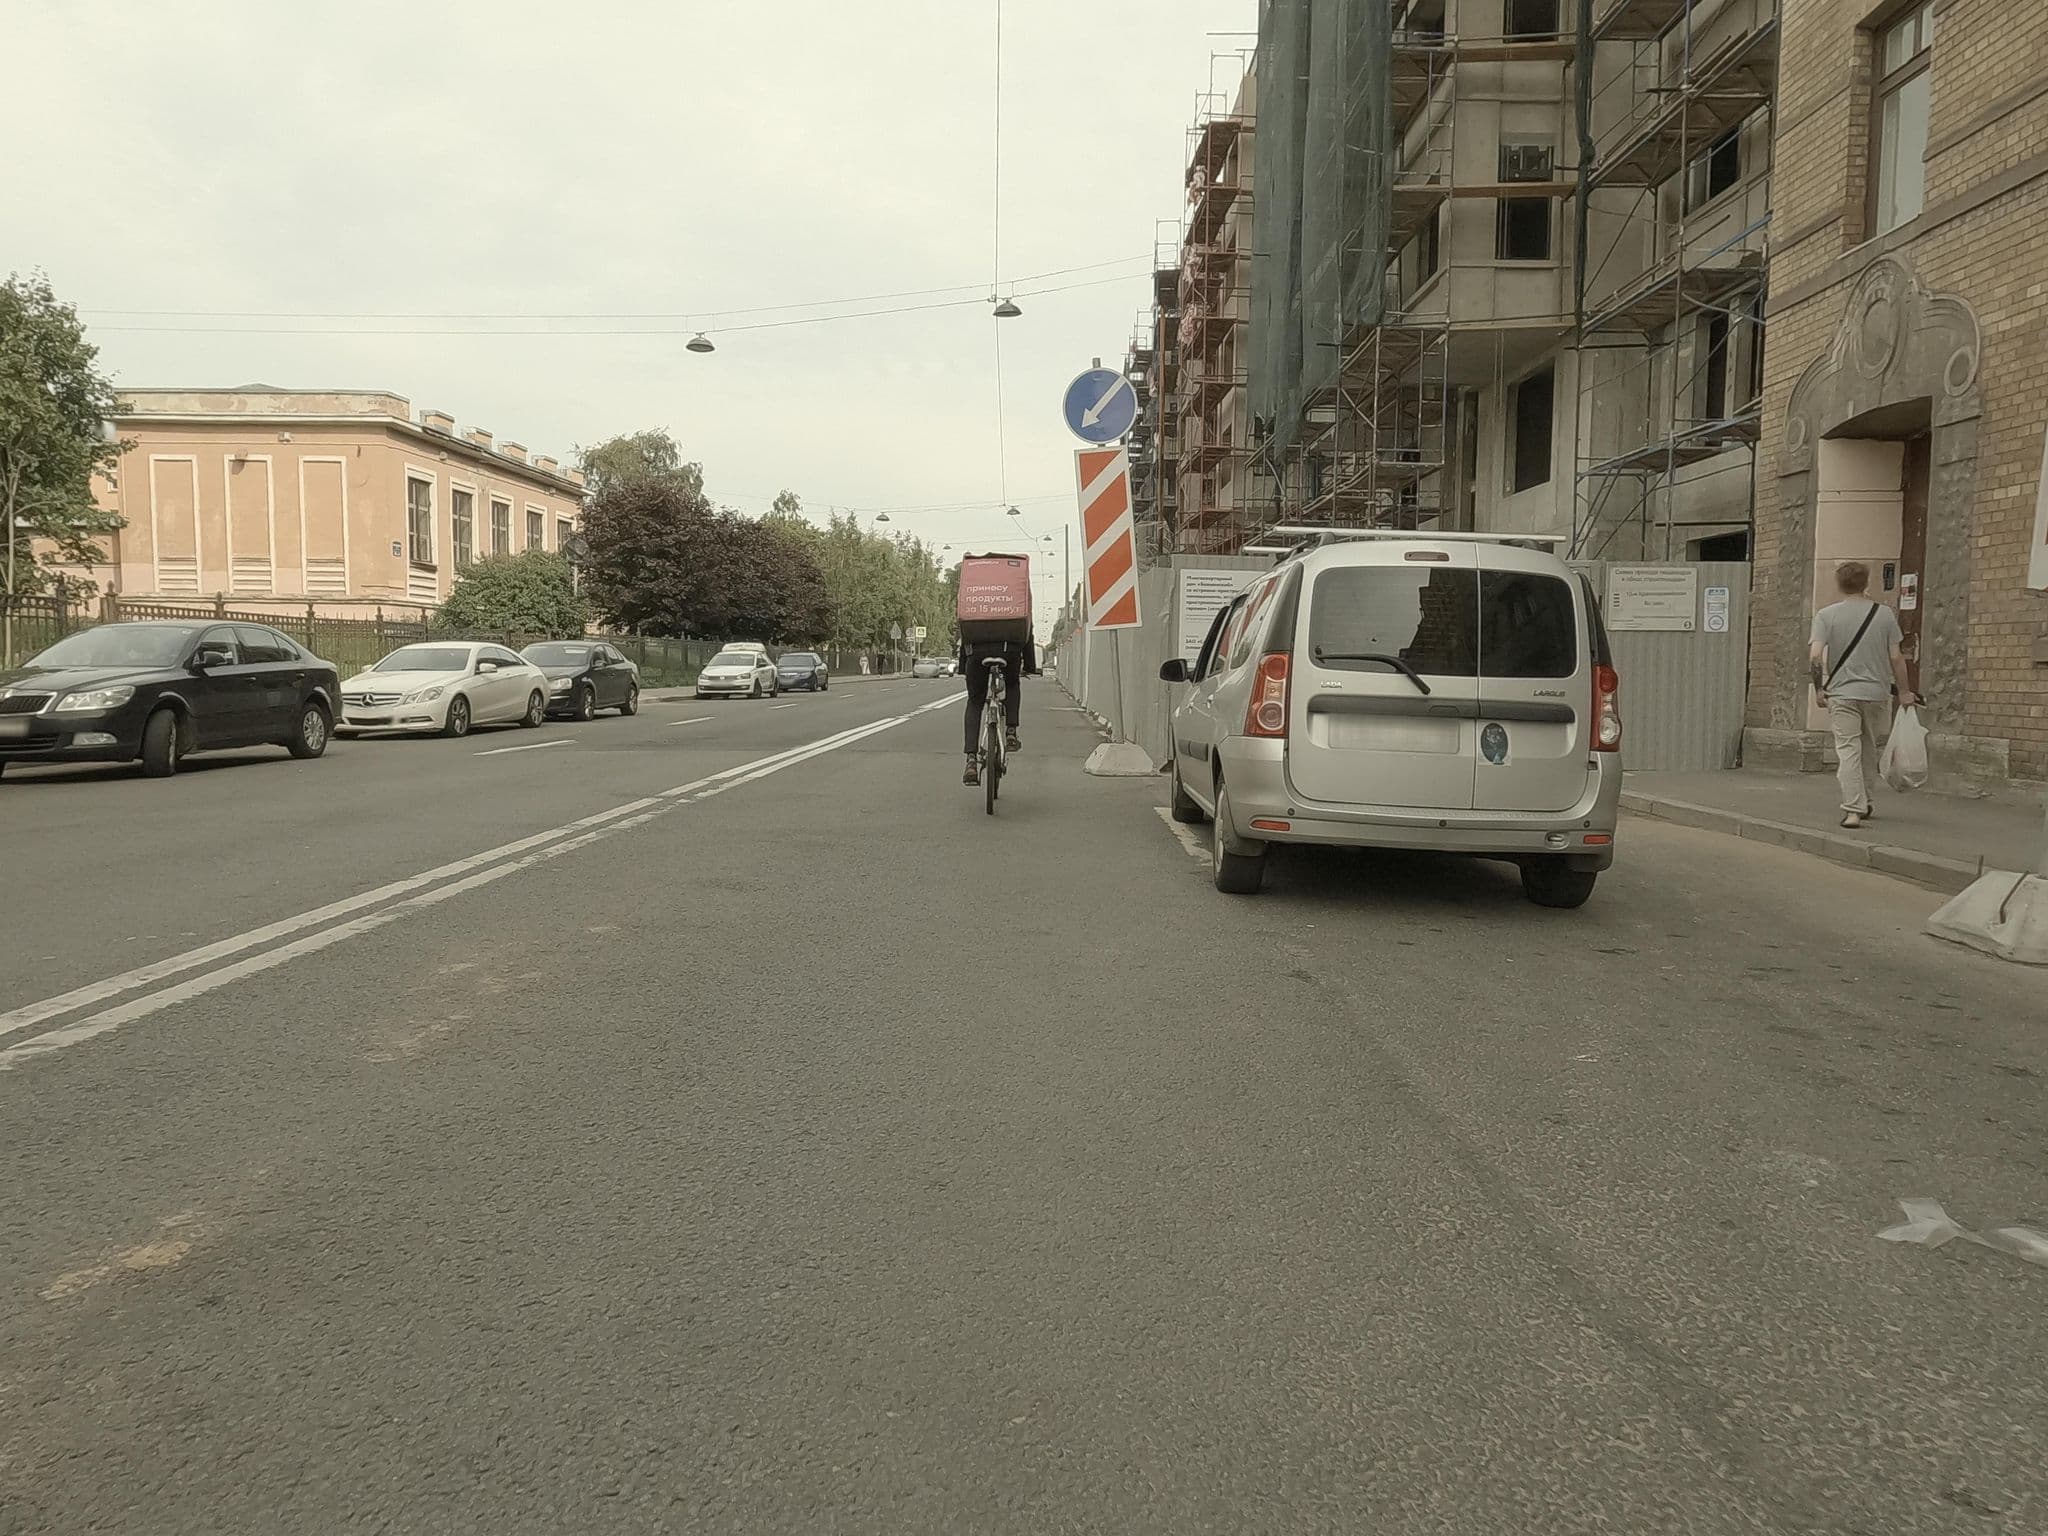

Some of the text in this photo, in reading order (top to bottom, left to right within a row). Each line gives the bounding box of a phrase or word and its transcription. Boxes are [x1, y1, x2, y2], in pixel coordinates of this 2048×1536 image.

[966, 585, 1008, 593] приносу
[966, 595, 1013, 603] продукты
[980, 604, 988, 612] 15
[990, 606, 1021, 614] минут
